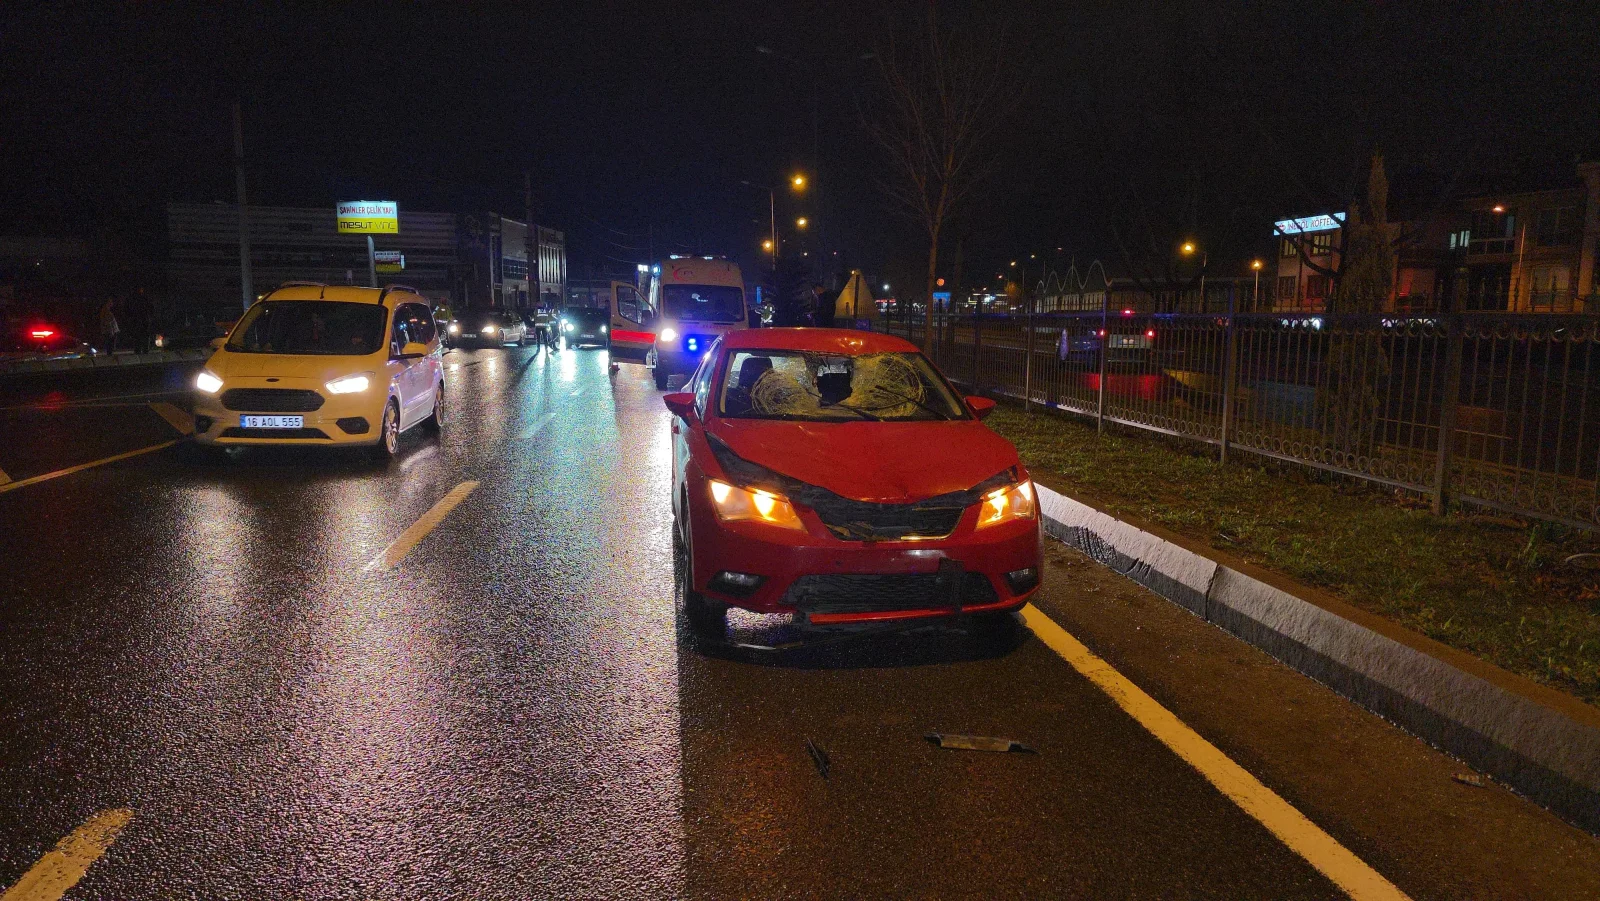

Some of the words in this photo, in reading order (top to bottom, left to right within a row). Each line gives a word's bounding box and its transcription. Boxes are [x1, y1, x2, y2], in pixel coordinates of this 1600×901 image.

[366, 205, 382, 215] ÇELİK
[247, 417, 258, 427] 16
[282, 417, 300, 427] 555
